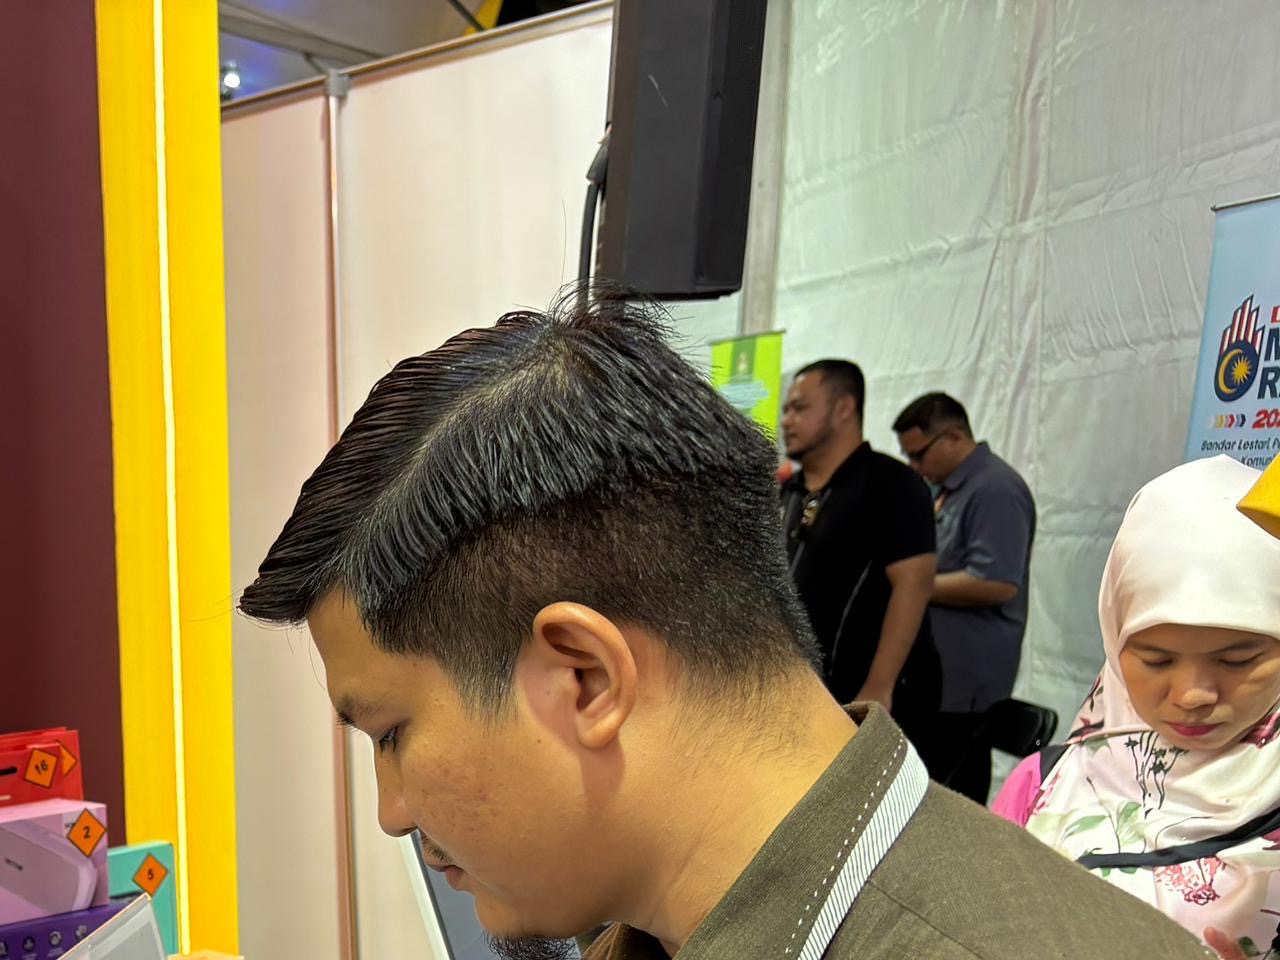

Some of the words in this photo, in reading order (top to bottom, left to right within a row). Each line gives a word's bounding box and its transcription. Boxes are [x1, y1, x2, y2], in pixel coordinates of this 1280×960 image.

[1201, 439, 1236, 452] Bandar
[1237, 436, 1271, 450] Lestari
[33, 759, 50, 775] 16
[82, 825, 92, 839] 2
[146, 868, 155, 881] 5
